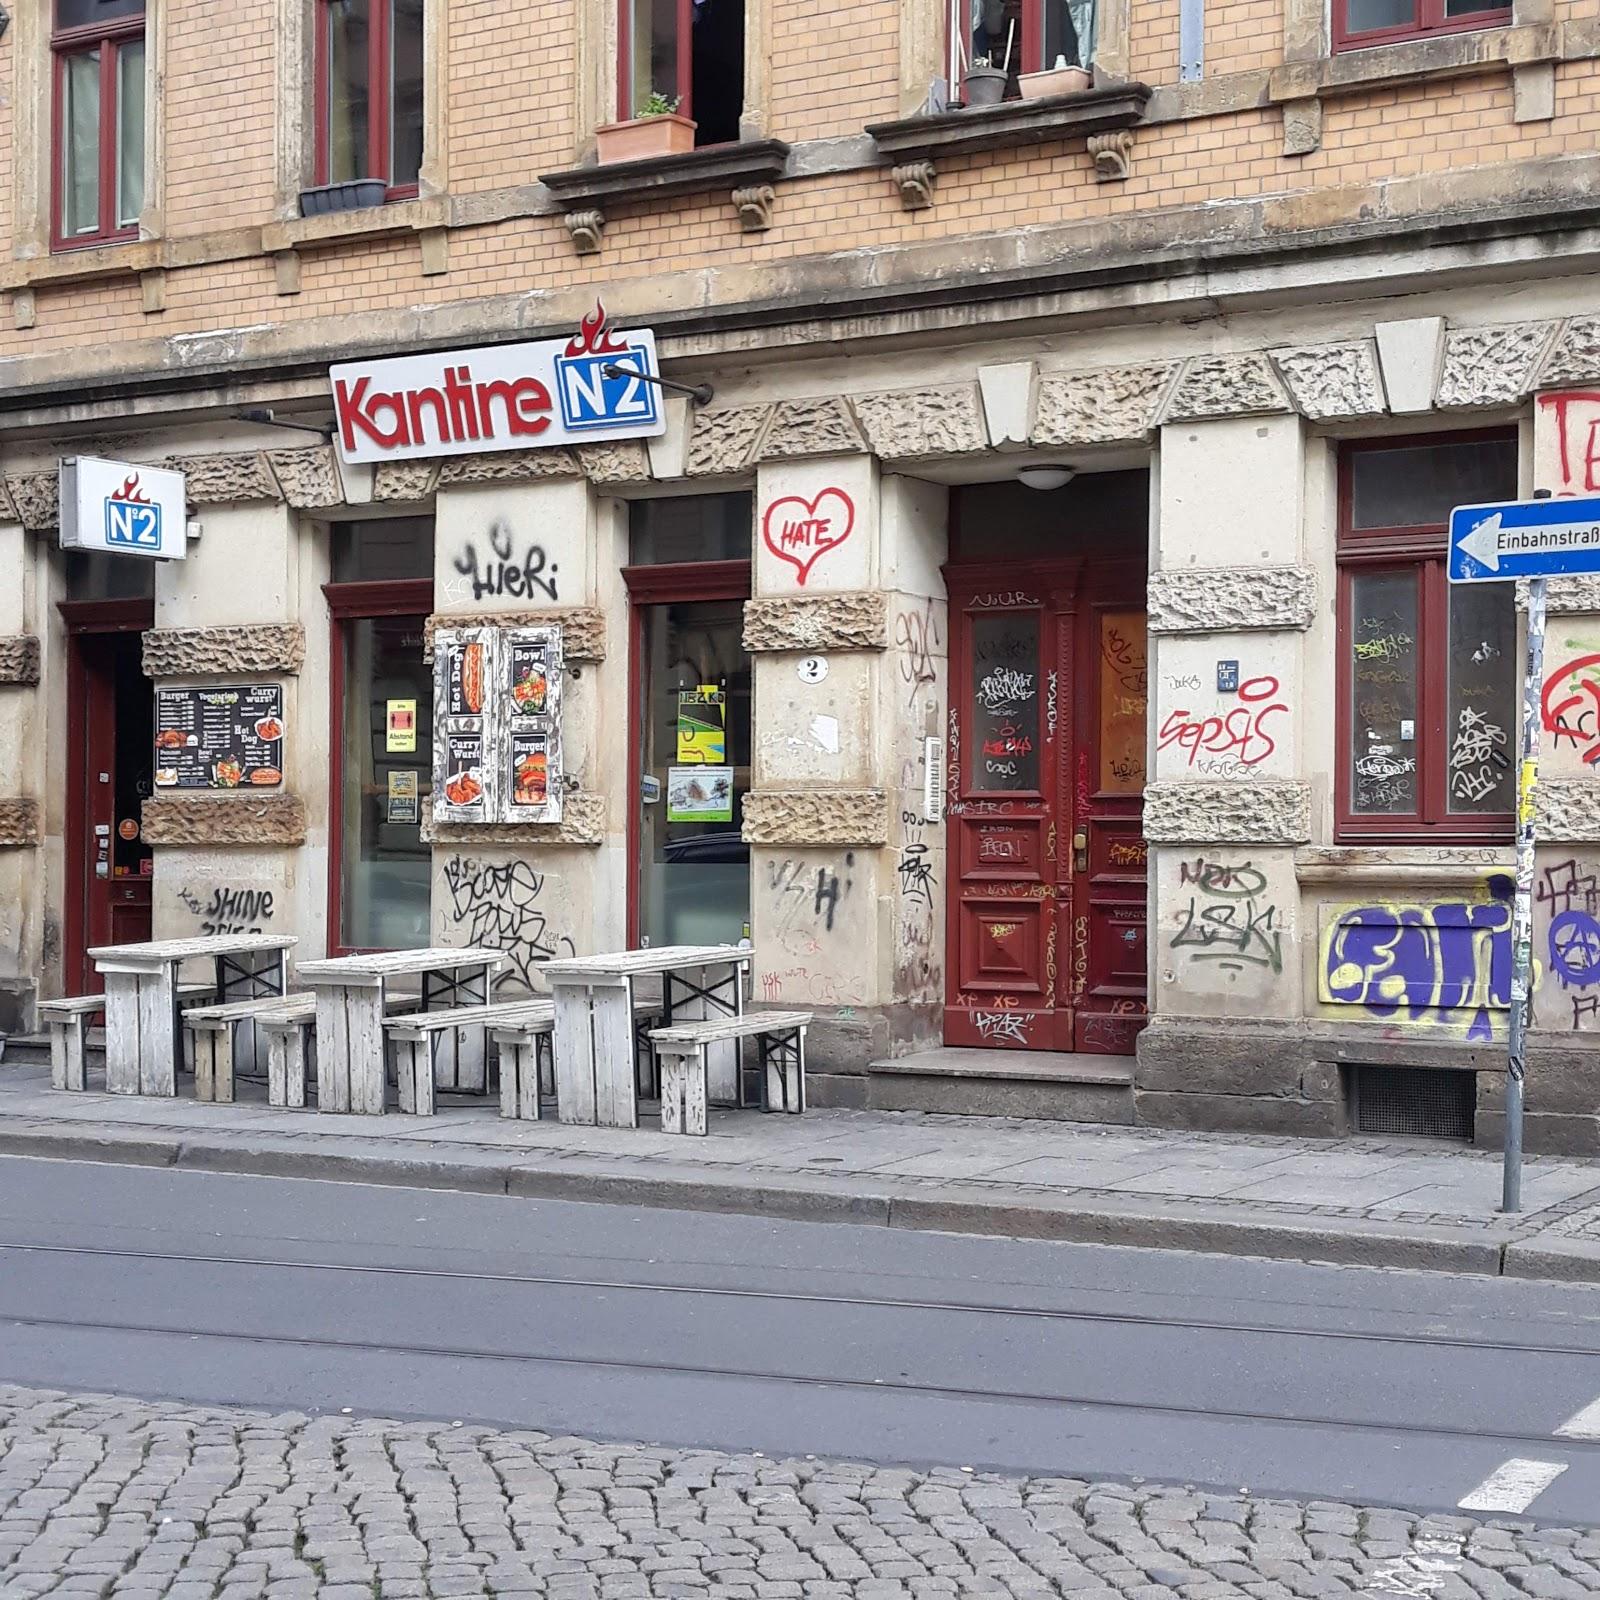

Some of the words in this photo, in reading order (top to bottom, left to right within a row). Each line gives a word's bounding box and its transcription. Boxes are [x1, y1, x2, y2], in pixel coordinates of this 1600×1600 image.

[335, 366, 553, 451] Kantine
[780, 518, 834, 550] HATE
[515, 649, 545, 662] Bowl
[807, 660, 818, 678] 2
[160, 692, 190, 701] Burger
[250, 687, 278, 699] Curry
[234, 725, 249, 735] Hot
[241, 735, 258, 744] Dog
[449, 739, 480, 752] Curry
[514, 741, 545, 754] Burger
